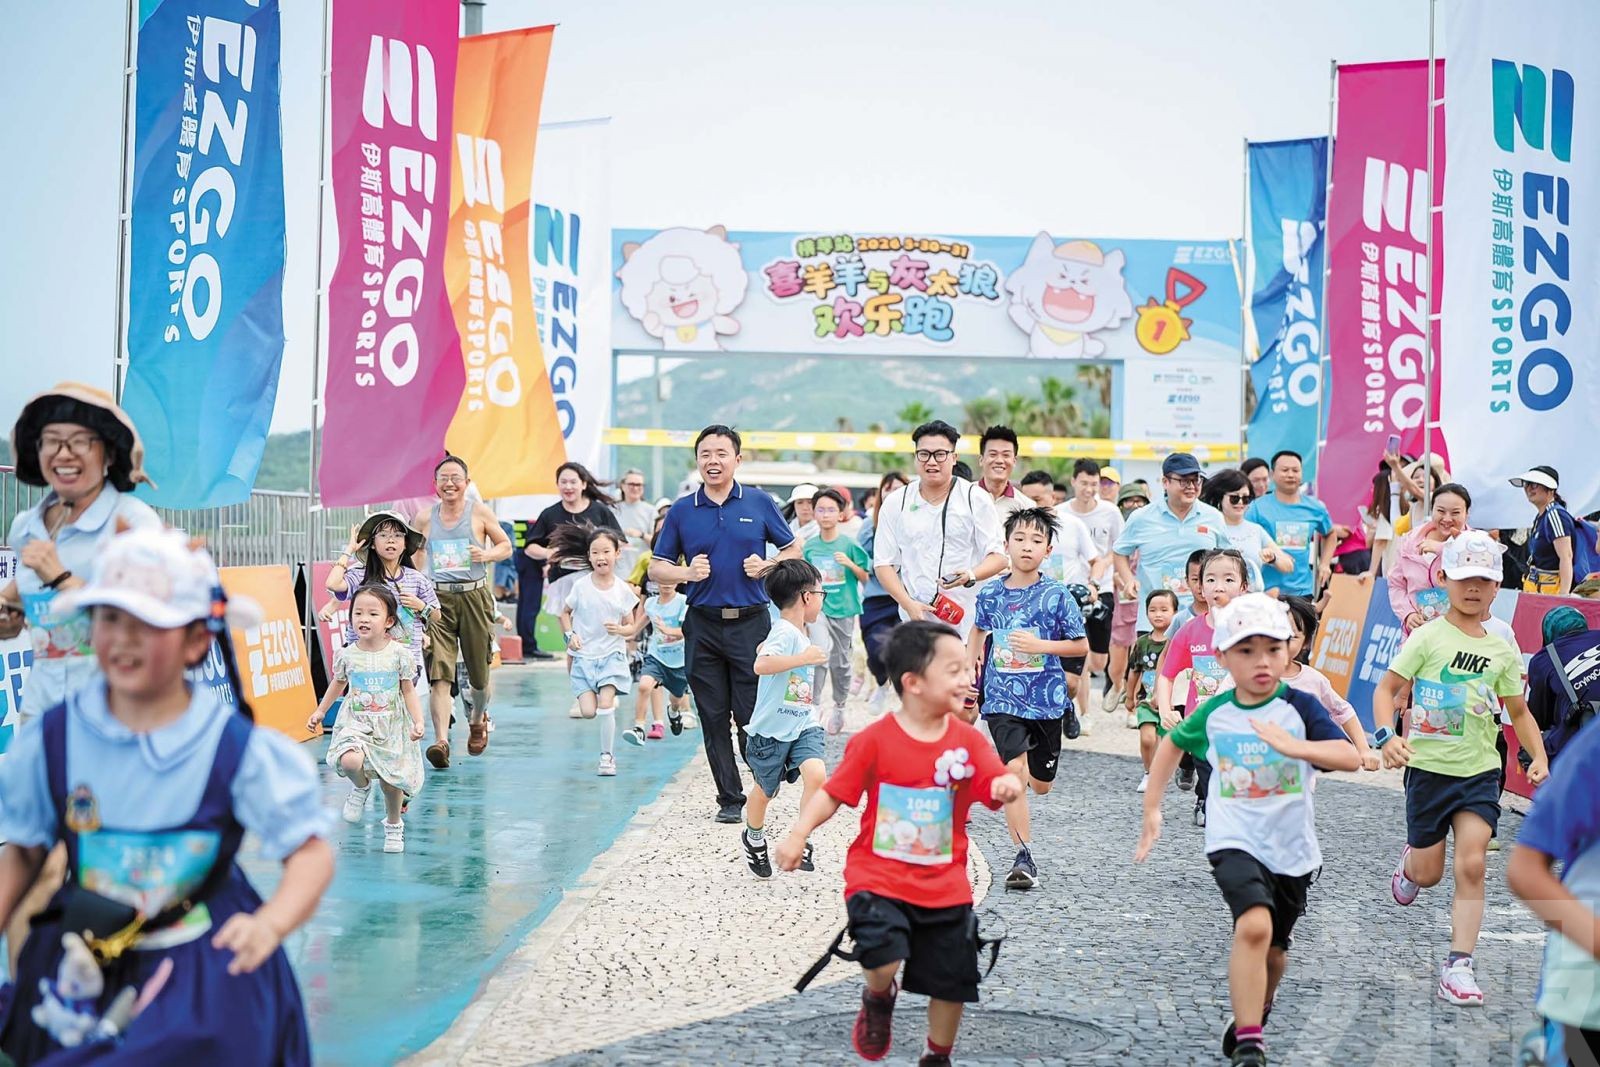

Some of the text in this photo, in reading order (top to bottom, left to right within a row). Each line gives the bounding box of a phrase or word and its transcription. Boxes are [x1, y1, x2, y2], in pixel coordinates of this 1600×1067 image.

[182, 16, 257, 341] EZGO
[379, 145, 437, 387] EZGO
[765, 254, 1000, 300] 喜羊羊与灰太狼
[480, 219, 522, 408] EZGO
[1517, 171, 1574, 412] EZGO
[812, 293, 954, 343] 欢乐跑
[1385, 244, 1435, 432] EZGO
[261, 618, 300, 668] EZGO
[1325, 617, 1358, 657] EZGO
[363, 676, 385, 686] 1017
[1450, 651, 1491, 675] NIKE
[776, 706, 798, 718] PLAYING
[1420, 686, 1444, 700] 2818
[1236, 742, 1269, 755] 1000
